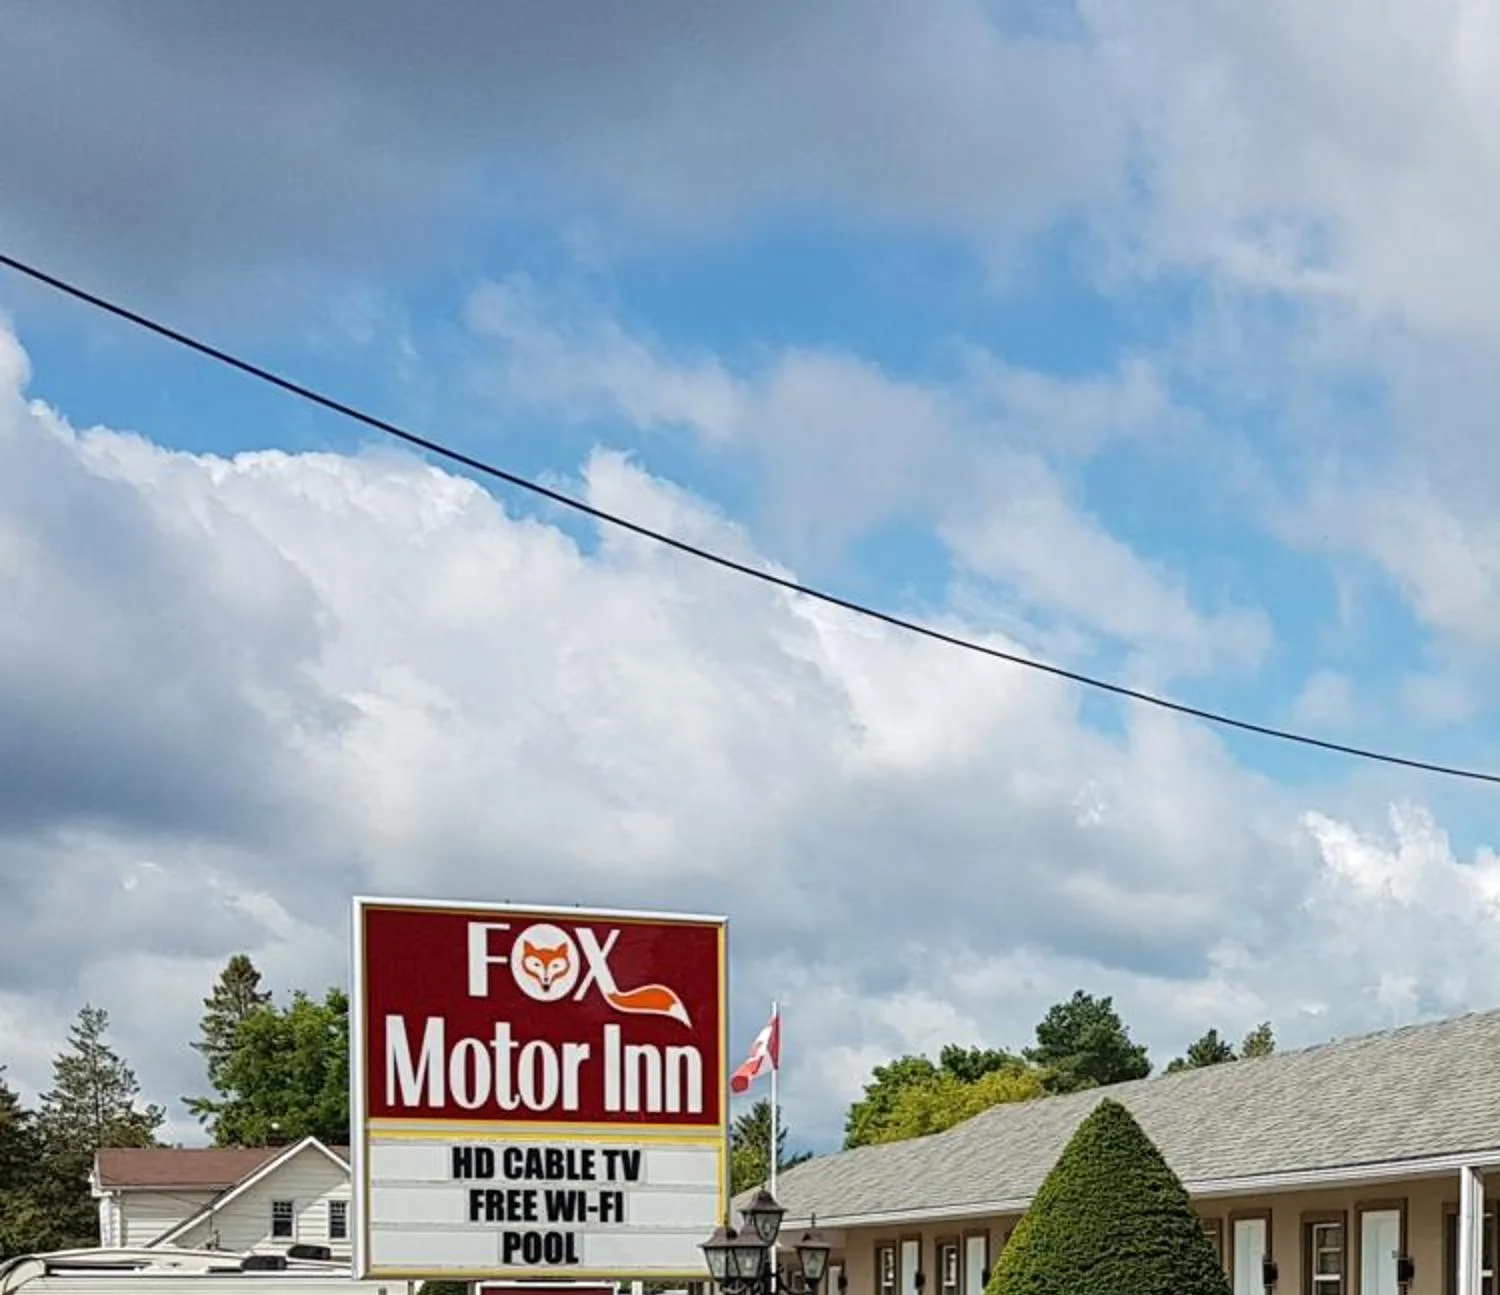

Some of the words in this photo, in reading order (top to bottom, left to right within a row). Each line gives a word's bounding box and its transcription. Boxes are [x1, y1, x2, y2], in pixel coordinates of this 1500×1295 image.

[467, 921, 621, 1003] FOX
[385, 1014, 591, 1112] Motor
[603, 1023, 703, 1114] Inn
[452, 1146, 495, 1180] HD
[503, 1147, 595, 1181] CABLE
[602, 1149, 641, 1181] TV
[469, 1189, 538, 1222] FREE
[545, 1190, 624, 1223] WI-FI
[503, 1231, 579, 1264] POOL
